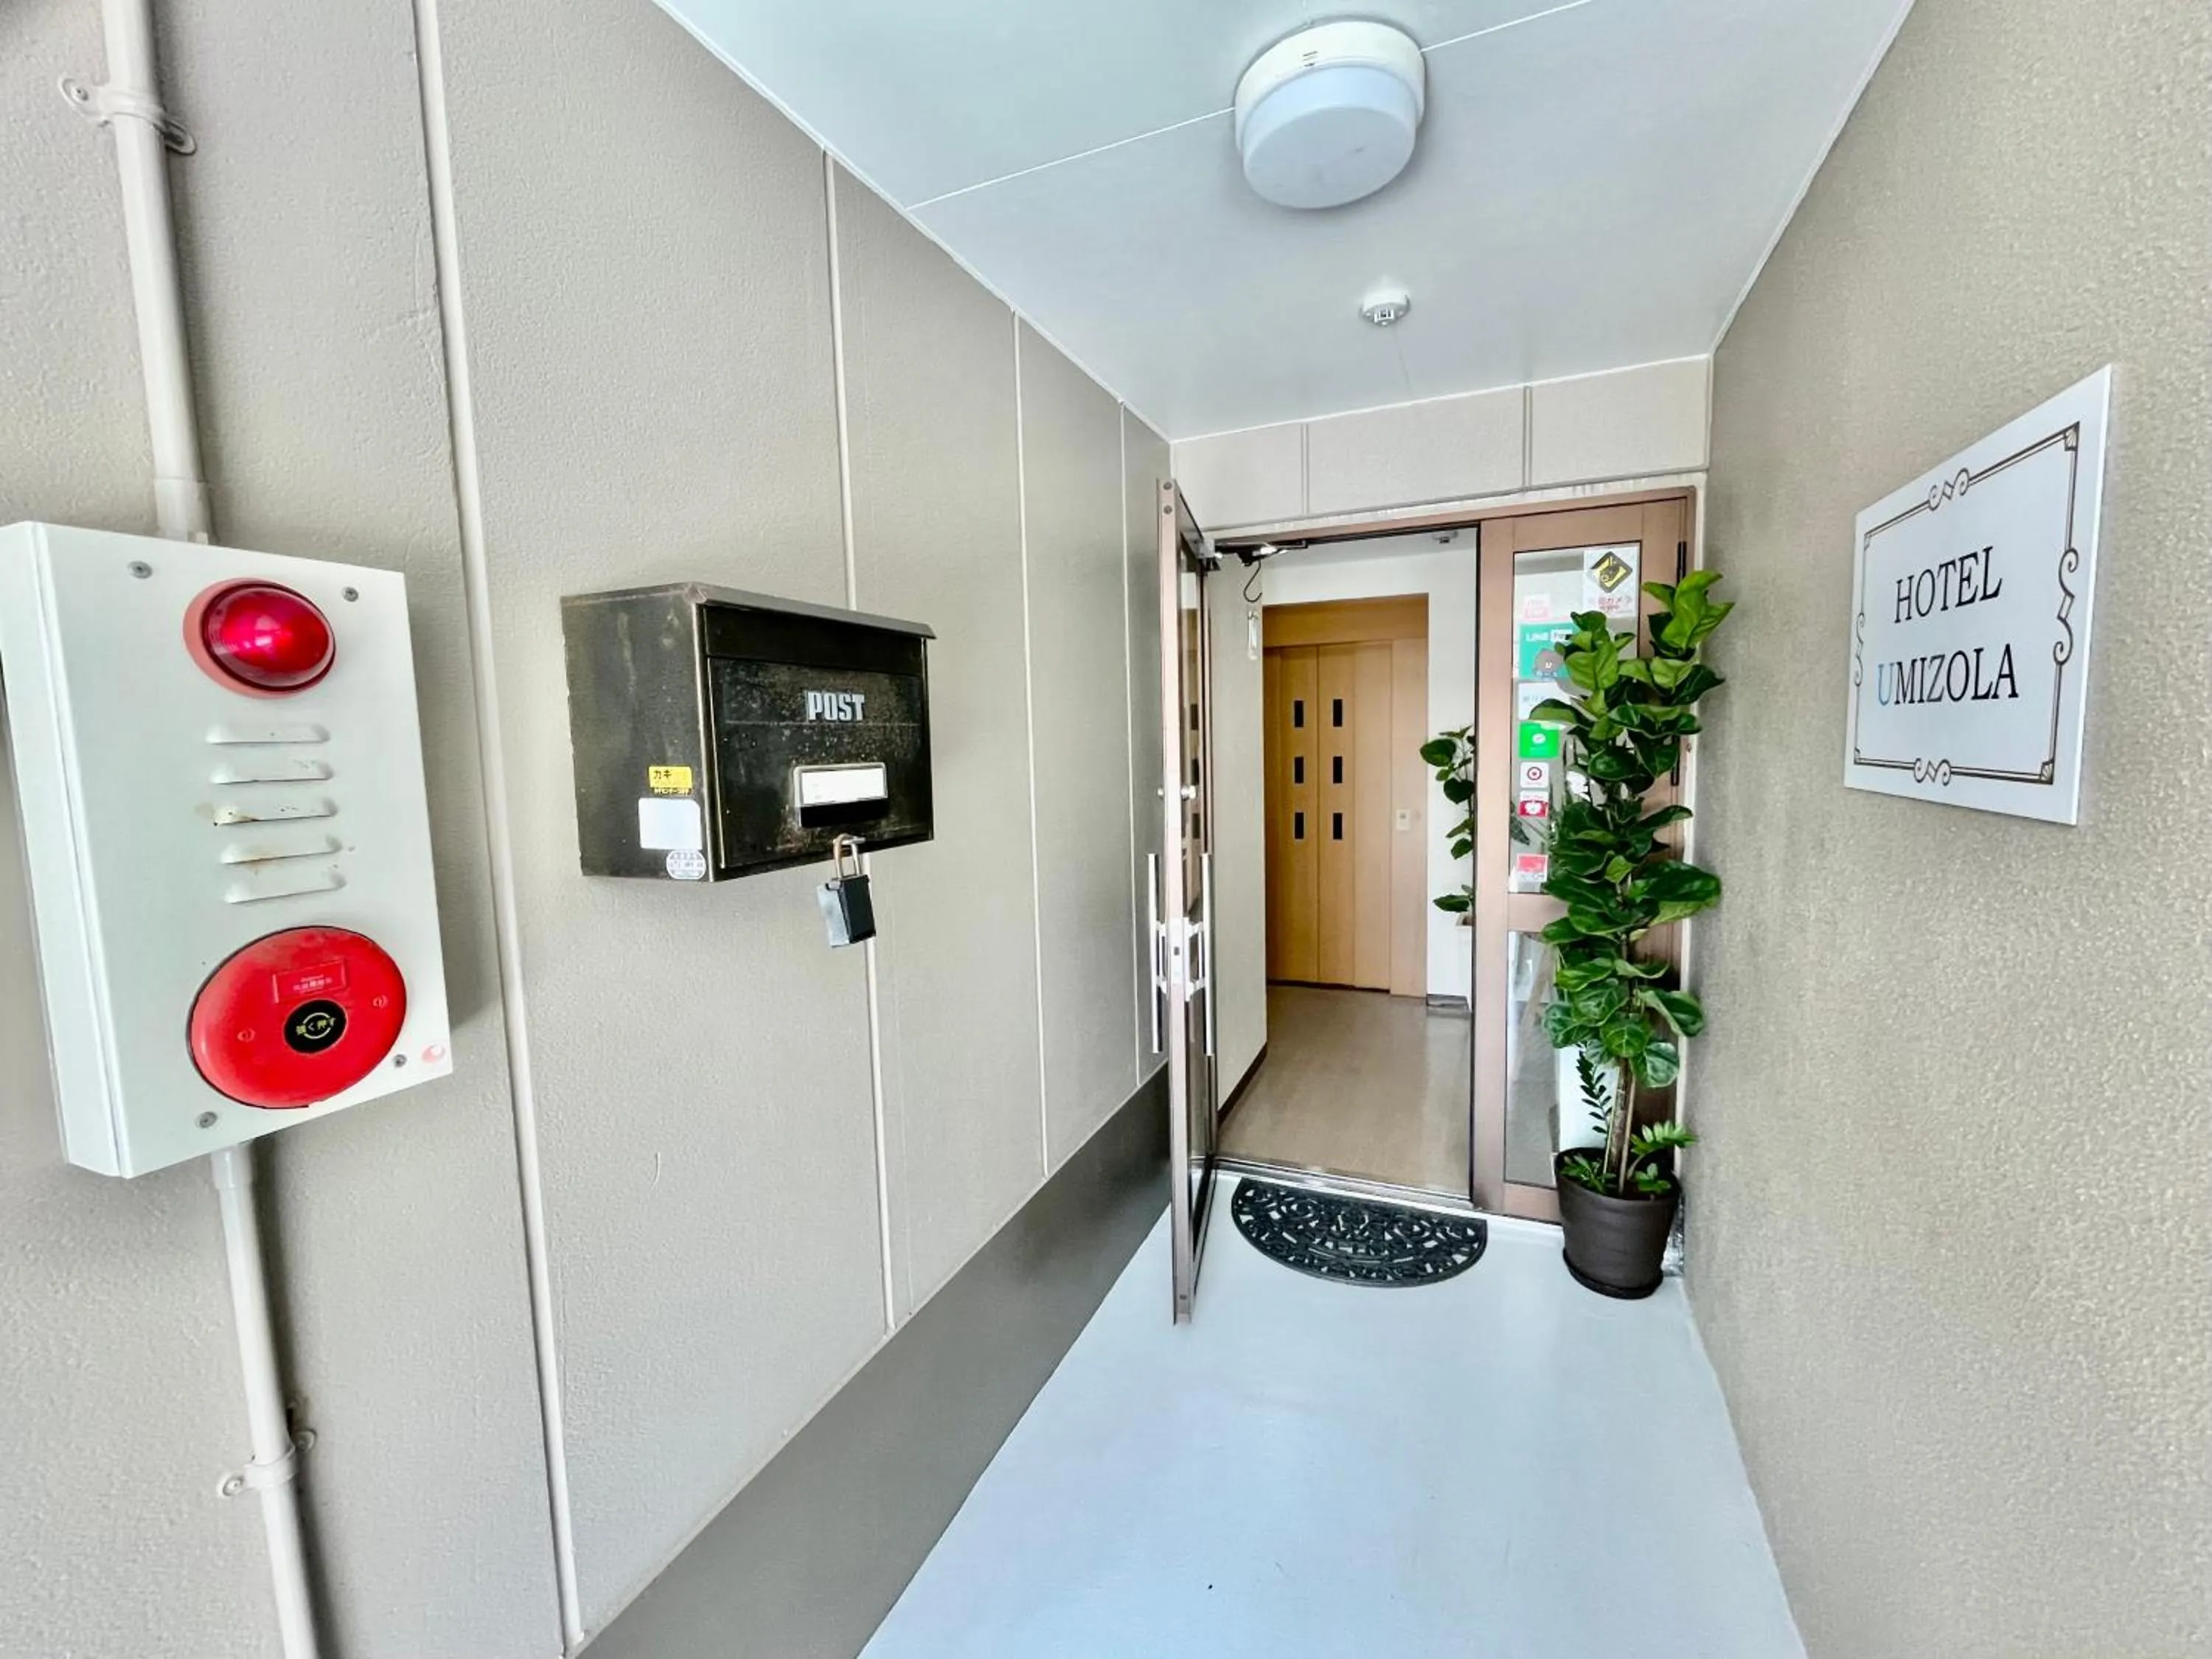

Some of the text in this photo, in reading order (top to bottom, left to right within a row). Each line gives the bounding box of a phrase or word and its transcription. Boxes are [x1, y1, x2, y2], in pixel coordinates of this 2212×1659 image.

[1894, 546, 2003, 624] HOTEL
[807, 691, 865, 720] POST
[1877, 643, 2020, 708] UMIZOLA
